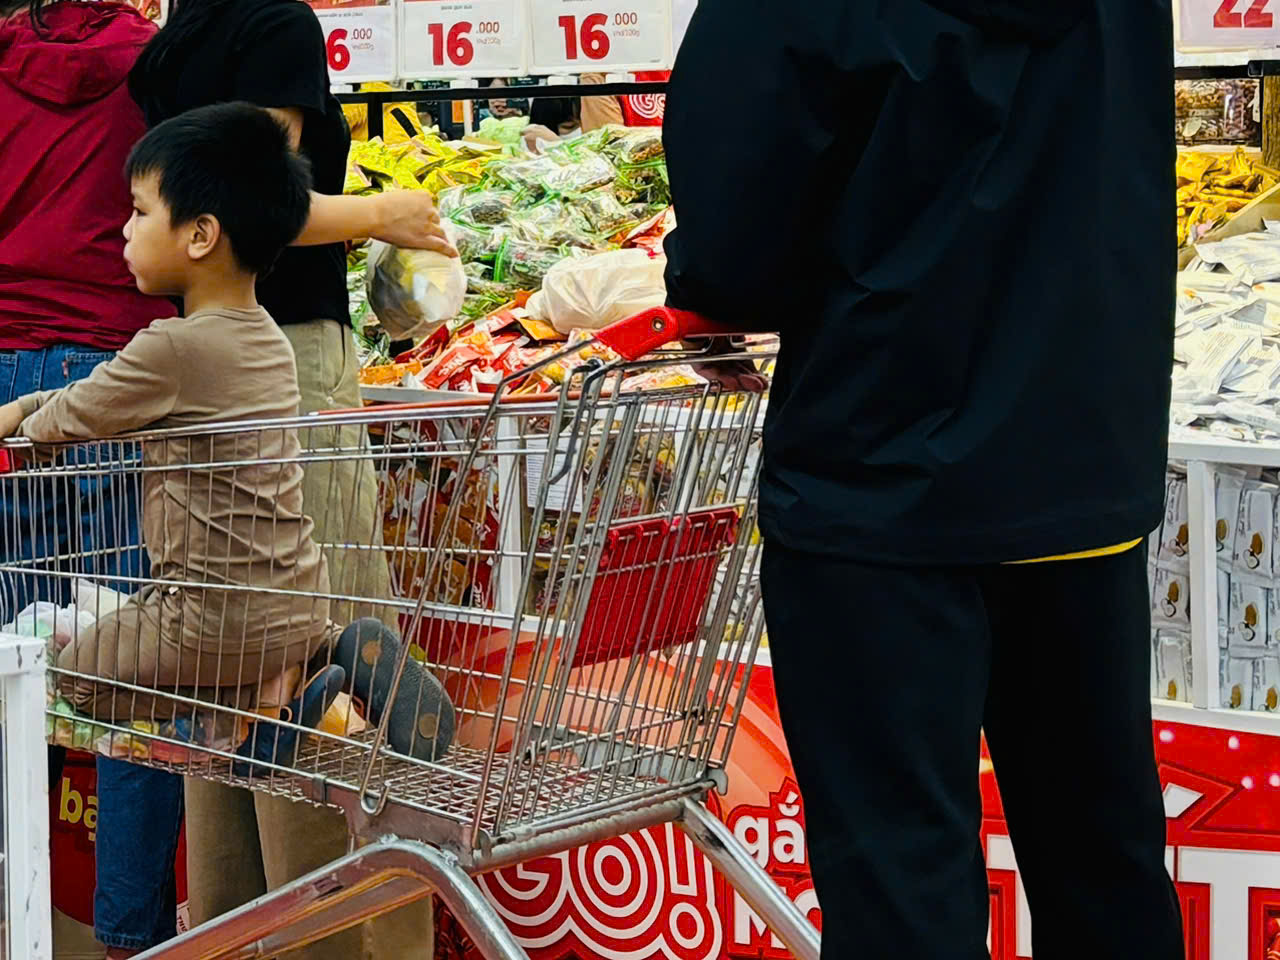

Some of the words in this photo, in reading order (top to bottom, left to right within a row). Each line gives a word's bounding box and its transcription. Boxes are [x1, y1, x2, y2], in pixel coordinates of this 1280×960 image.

[428, 21, 474, 66] 16
[558, 13, 610, 60] 16
[733, 795, 806, 869] gắ
